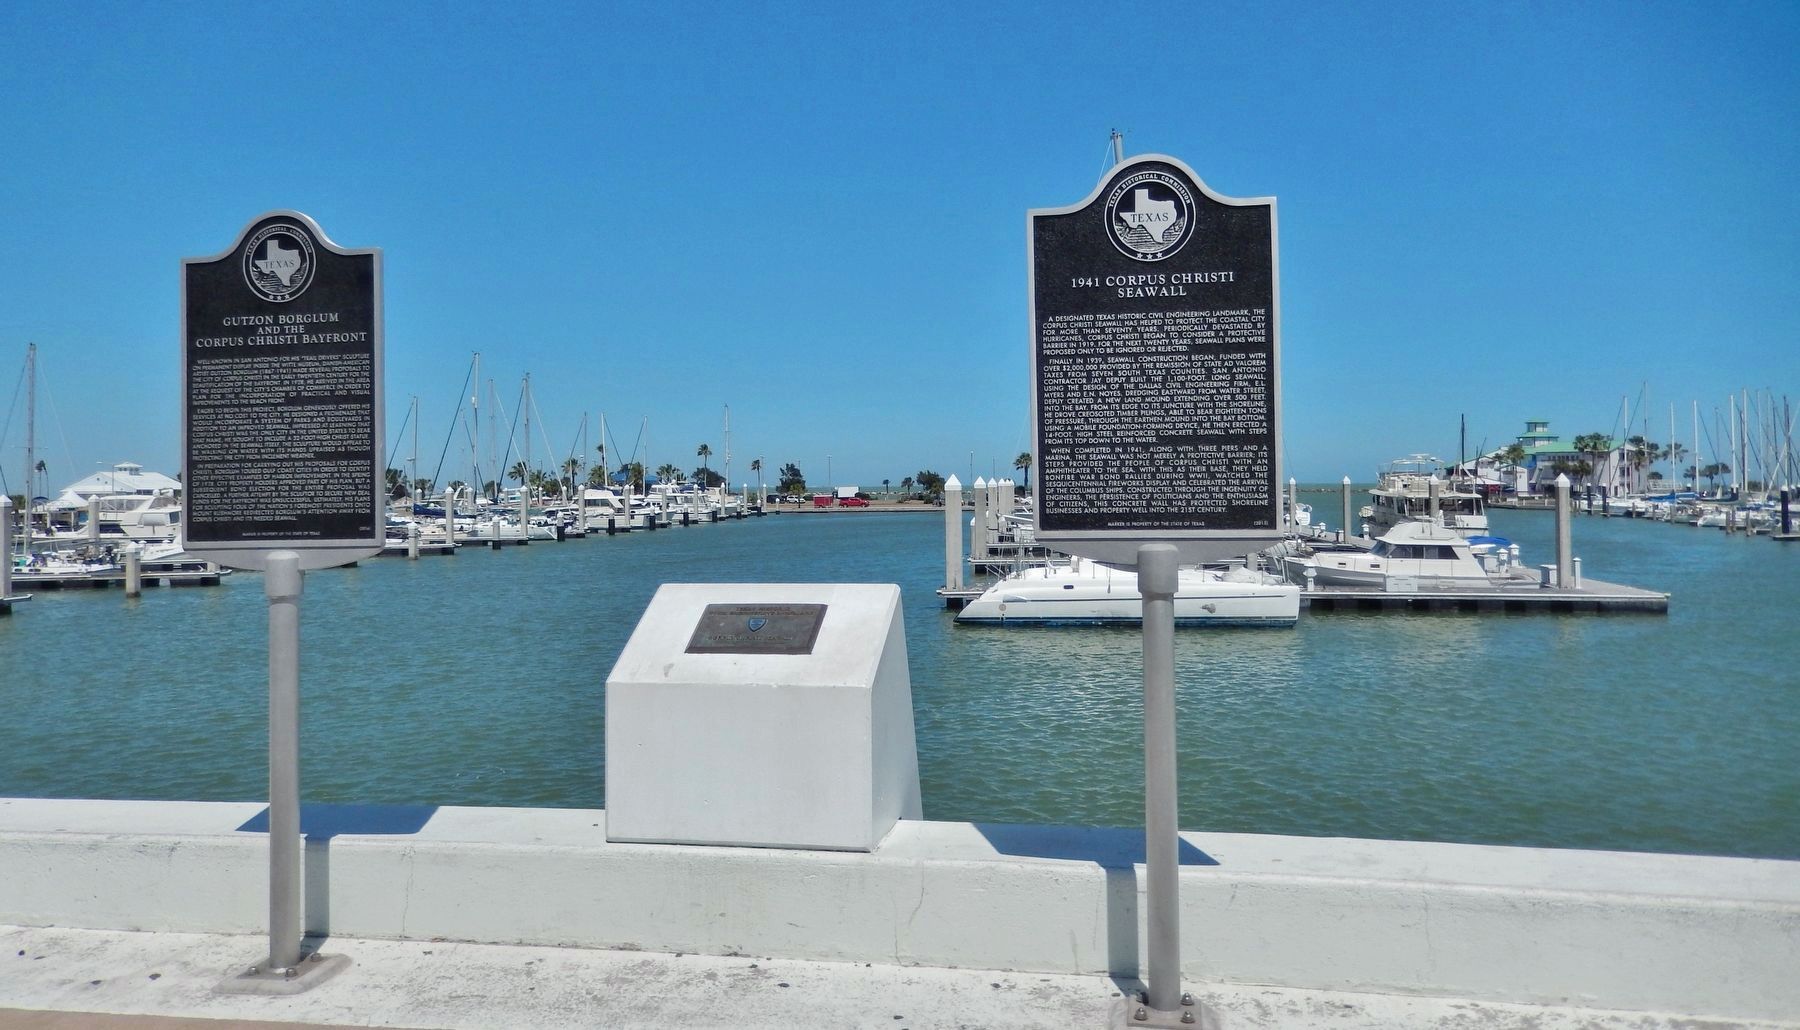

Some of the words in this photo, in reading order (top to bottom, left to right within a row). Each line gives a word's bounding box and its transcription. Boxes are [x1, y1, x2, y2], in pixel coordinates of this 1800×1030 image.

[1109, 189, 1121, 207] TEXAS
[1122, 174, 1158, 188] HISTORICAL
[1161, 176, 1191, 204] COMMISSION
[1131, 212, 1169, 222] TEXAS
[264, 260, 295, 269] TEXAS
[1071, 277, 1100, 288] 1941
[1106, 274, 1166, 286] CORPUS
[1171, 272, 1234, 284] CHRISTI
[1118, 286, 1187, 298] SEAWALL
[223, 316, 274, 326] GUTZON
[279, 313, 339, 324] BORGLUM
[257, 326, 280, 334] AND
[284, 325, 305, 333] THE
[196, 337, 243, 347] CORPUS
[248, 335, 298, 345] CHRISTI
[303, 332, 367, 344] BAYFRONT
